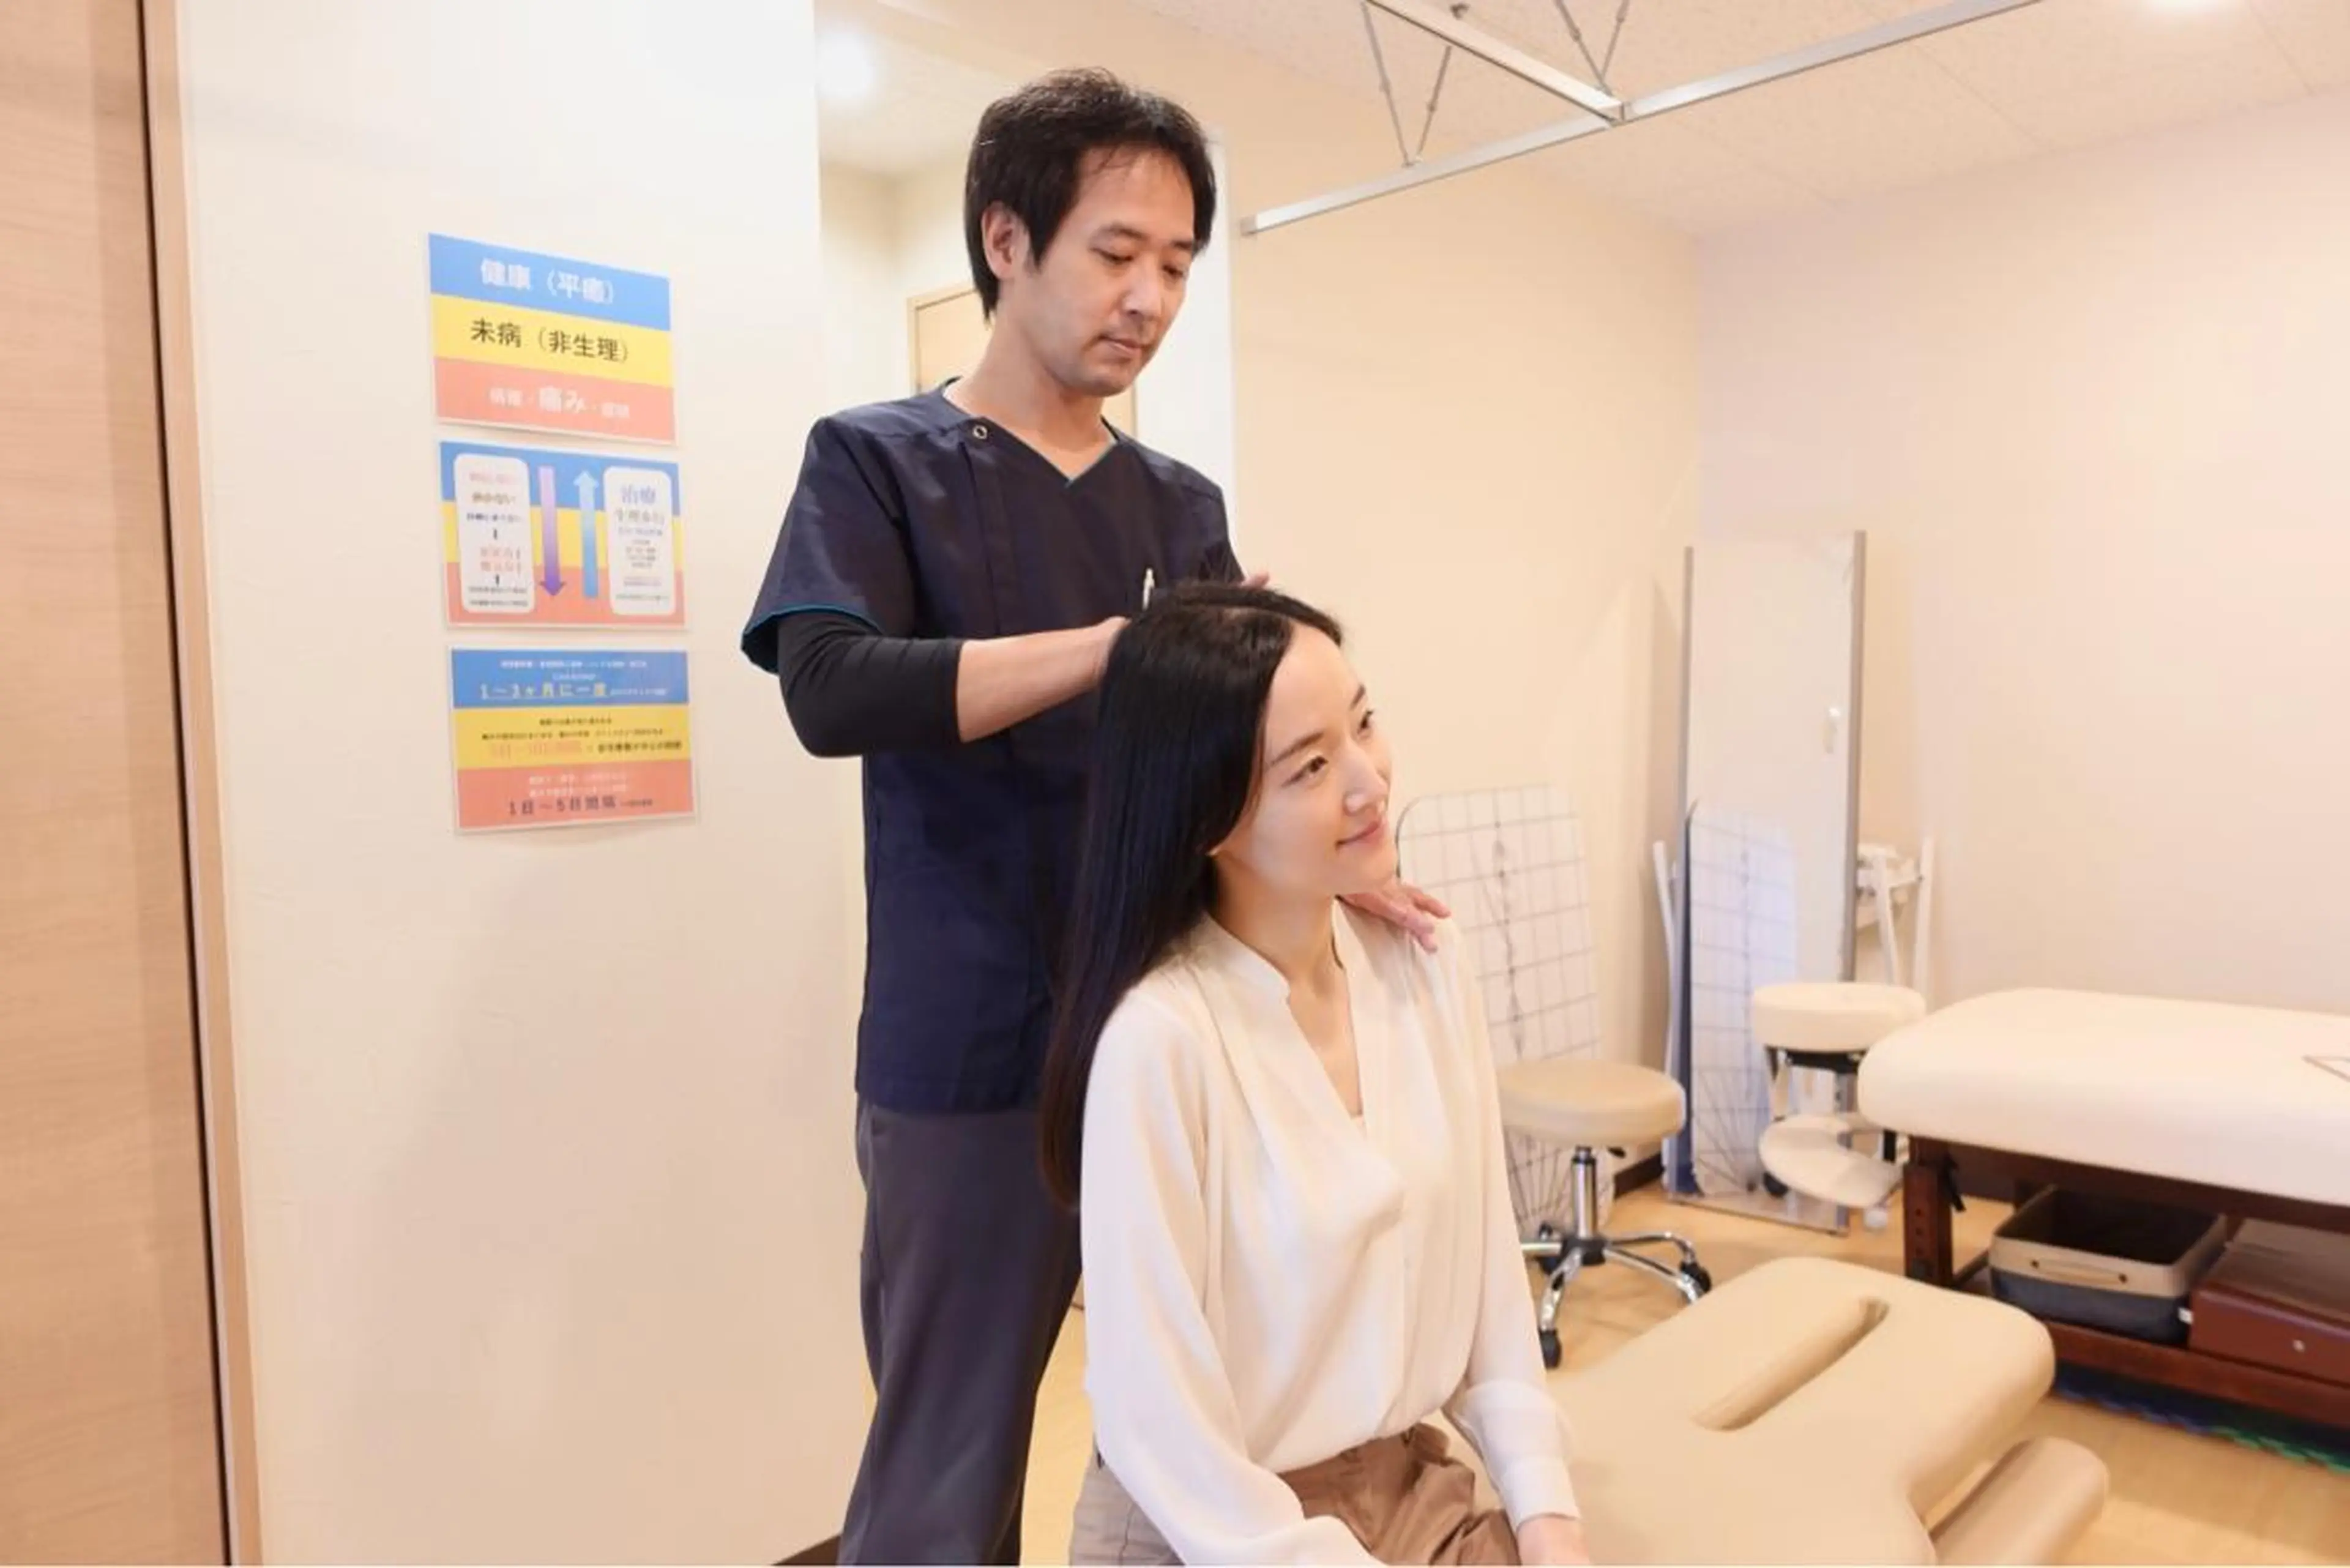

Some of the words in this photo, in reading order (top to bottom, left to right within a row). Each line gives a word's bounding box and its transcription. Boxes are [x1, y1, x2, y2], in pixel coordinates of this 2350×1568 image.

[471, 317, 629, 362] 未病（非生理）
